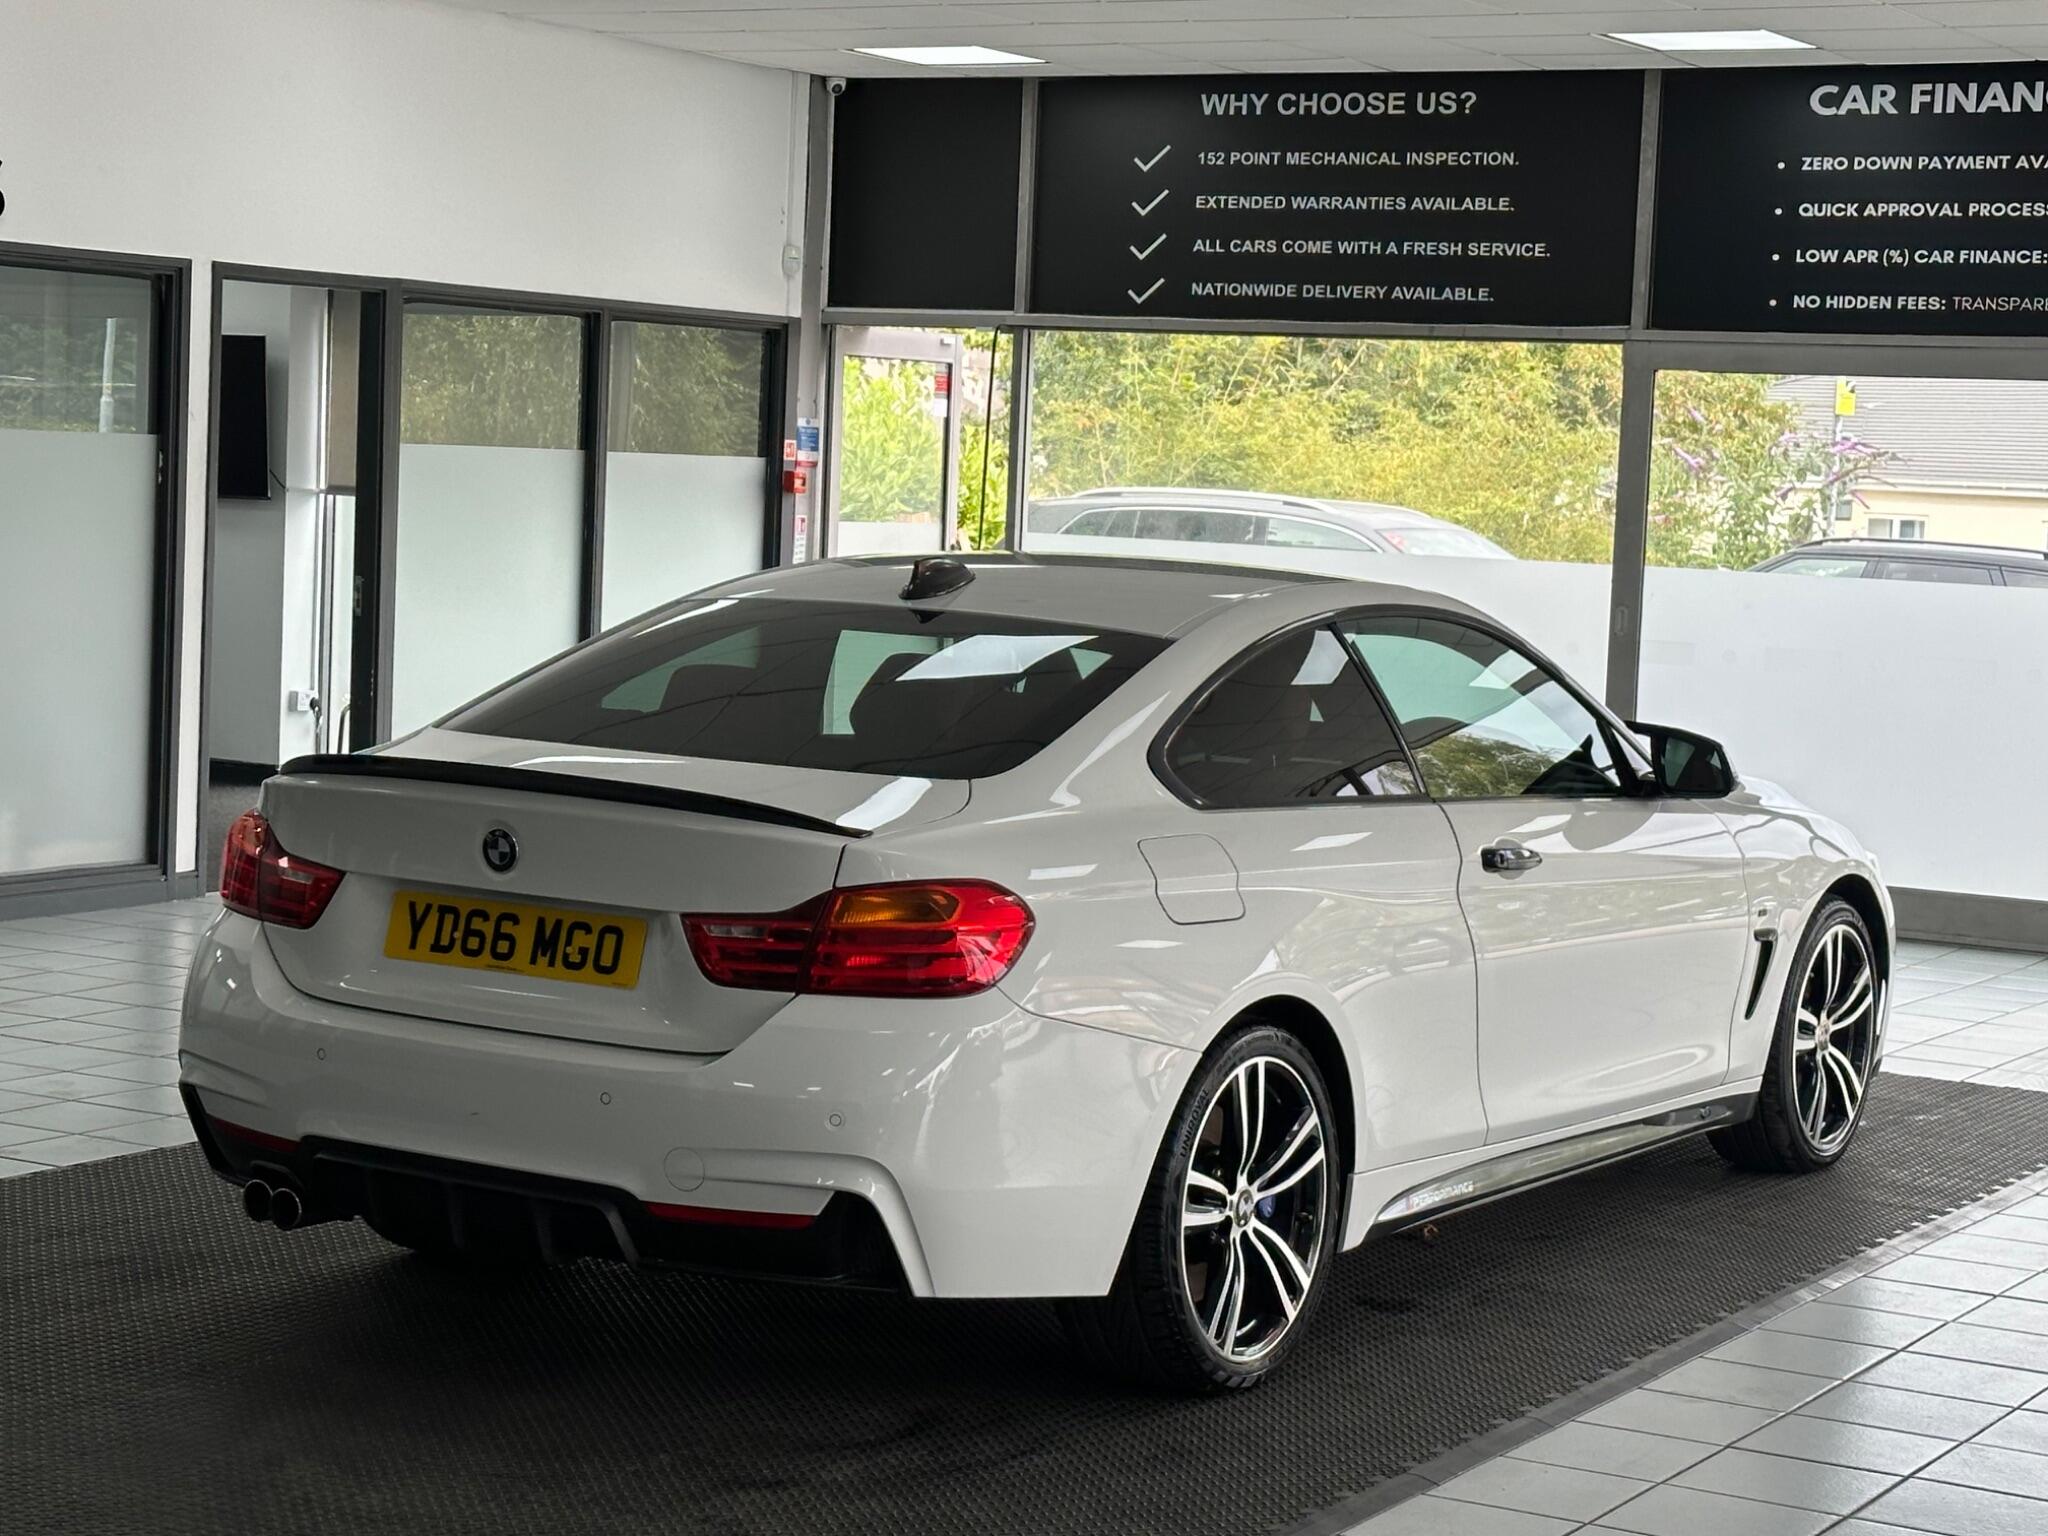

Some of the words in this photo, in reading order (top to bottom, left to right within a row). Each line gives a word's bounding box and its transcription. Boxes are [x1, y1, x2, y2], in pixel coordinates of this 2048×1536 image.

[1200, 93, 1269, 116] WHY
[1277, 92, 1406, 116] CHOOSE
[1416, 91, 1477, 115] US?
[1809, 84, 1899, 116] CAR
[1910, 80, 2048, 115] FINAN
[1198, 151, 1225, 166] 152
[1229, 151, 1282, 166] POINT
[1286, 151, 1401, 166] MECHANICAL
[1406, 151, 1519, 166] INSPECTION.
[1801, 156, 1849, 171] ZERO
[1853, 155, 1913, 171] DOWN
[1917, 155, 2012, 170] PAYMENT
[1195, 195, 1286, 209] EXTENDED
[1290, 195, 1407, 210] WARRANTIES
[1410, 196, 1515, 212] AVAILABLE.
[1798, 202, 1859, 217] QUICK
[1862, 202, 1963, 217] APPROVAL
[1192, 238, 1225, 253] ALL
[1229, 239, 1277, 253] CARS
[1282, 240, 1333, 254] COME
[1337, 240, 1382, 255] WITH
[1385, 241, 1399, 255] A
[1402, 241, 1462, 256] FRESH
[1467, 242, 1551, 257] SERVICE.
[1795, 249, 1840, 263] LOW
[1842, 249, 1879, 264] APR
[1882, 248, 1909, 267] (%)
[1913, 249, 1955, 264] CAR
[1959, 249, 2048, 264] FINANCE:
[1191, 282, 1297, 297] NATIONWIDE
[1302, 284, 1388, 299] DELIVERY
[1391, 286, 1494, 302] AVAILABLE.
[1792, 294, 1821, 309] NO
[1825, 295, 1892, 310] HIDDEN
[1896, 295, 1947, 311] FEES:
[408, 900, 520, 962] YD66
[529, 916, 624, 975] MGO
[1179, 1087, 1210, 1158] UNIROYAL
